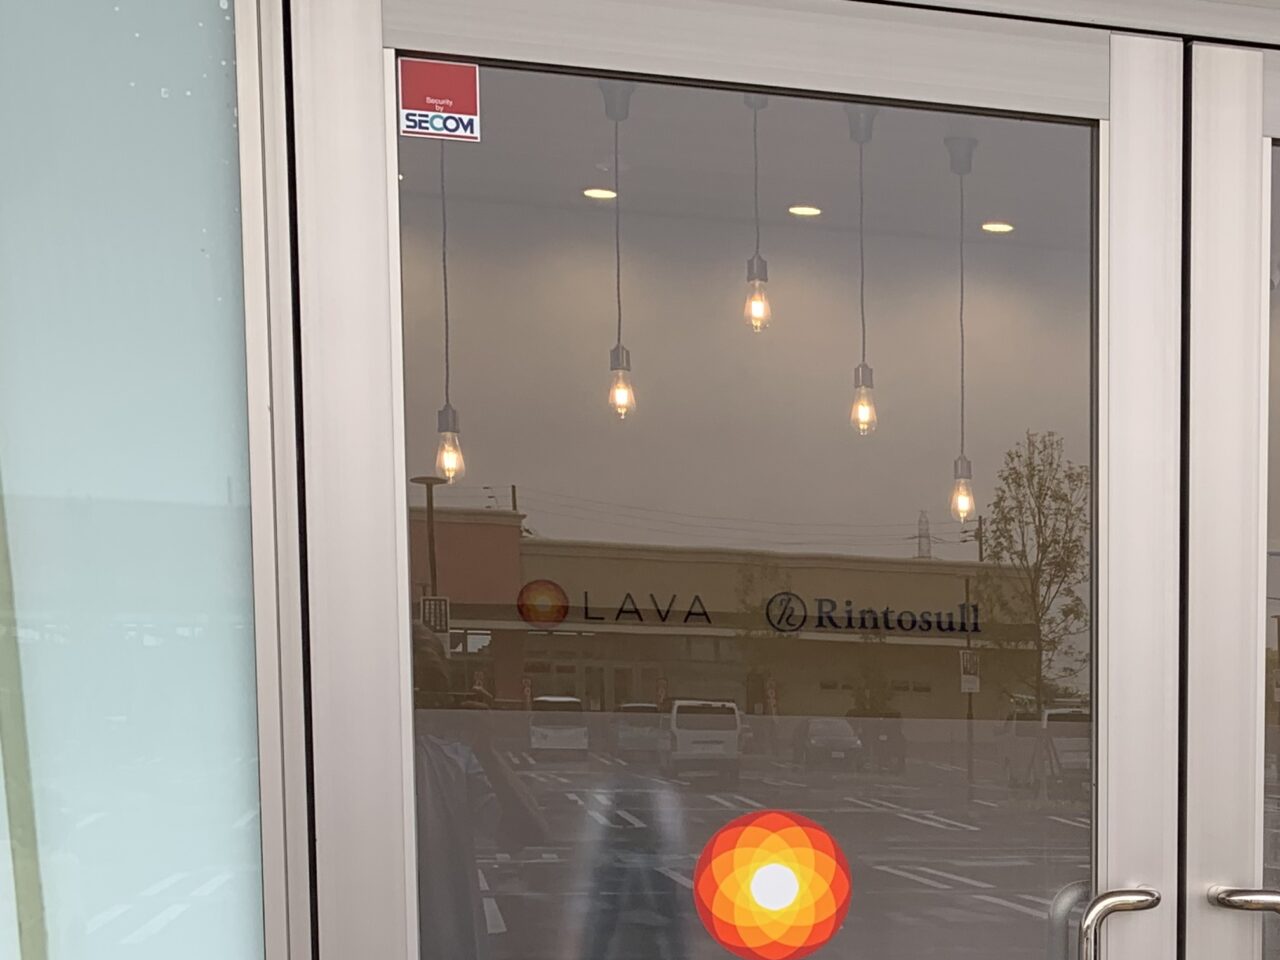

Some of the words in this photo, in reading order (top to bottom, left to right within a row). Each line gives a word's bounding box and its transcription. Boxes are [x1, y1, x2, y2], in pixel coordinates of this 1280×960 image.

[426, 96, 453, 107] Security
[435, 104, 444, 112] by
[405, 112, 474, 134] SECOM
[584, 592, 712, 624] LAVA
[814, 598, 981, 633] Rintosull
